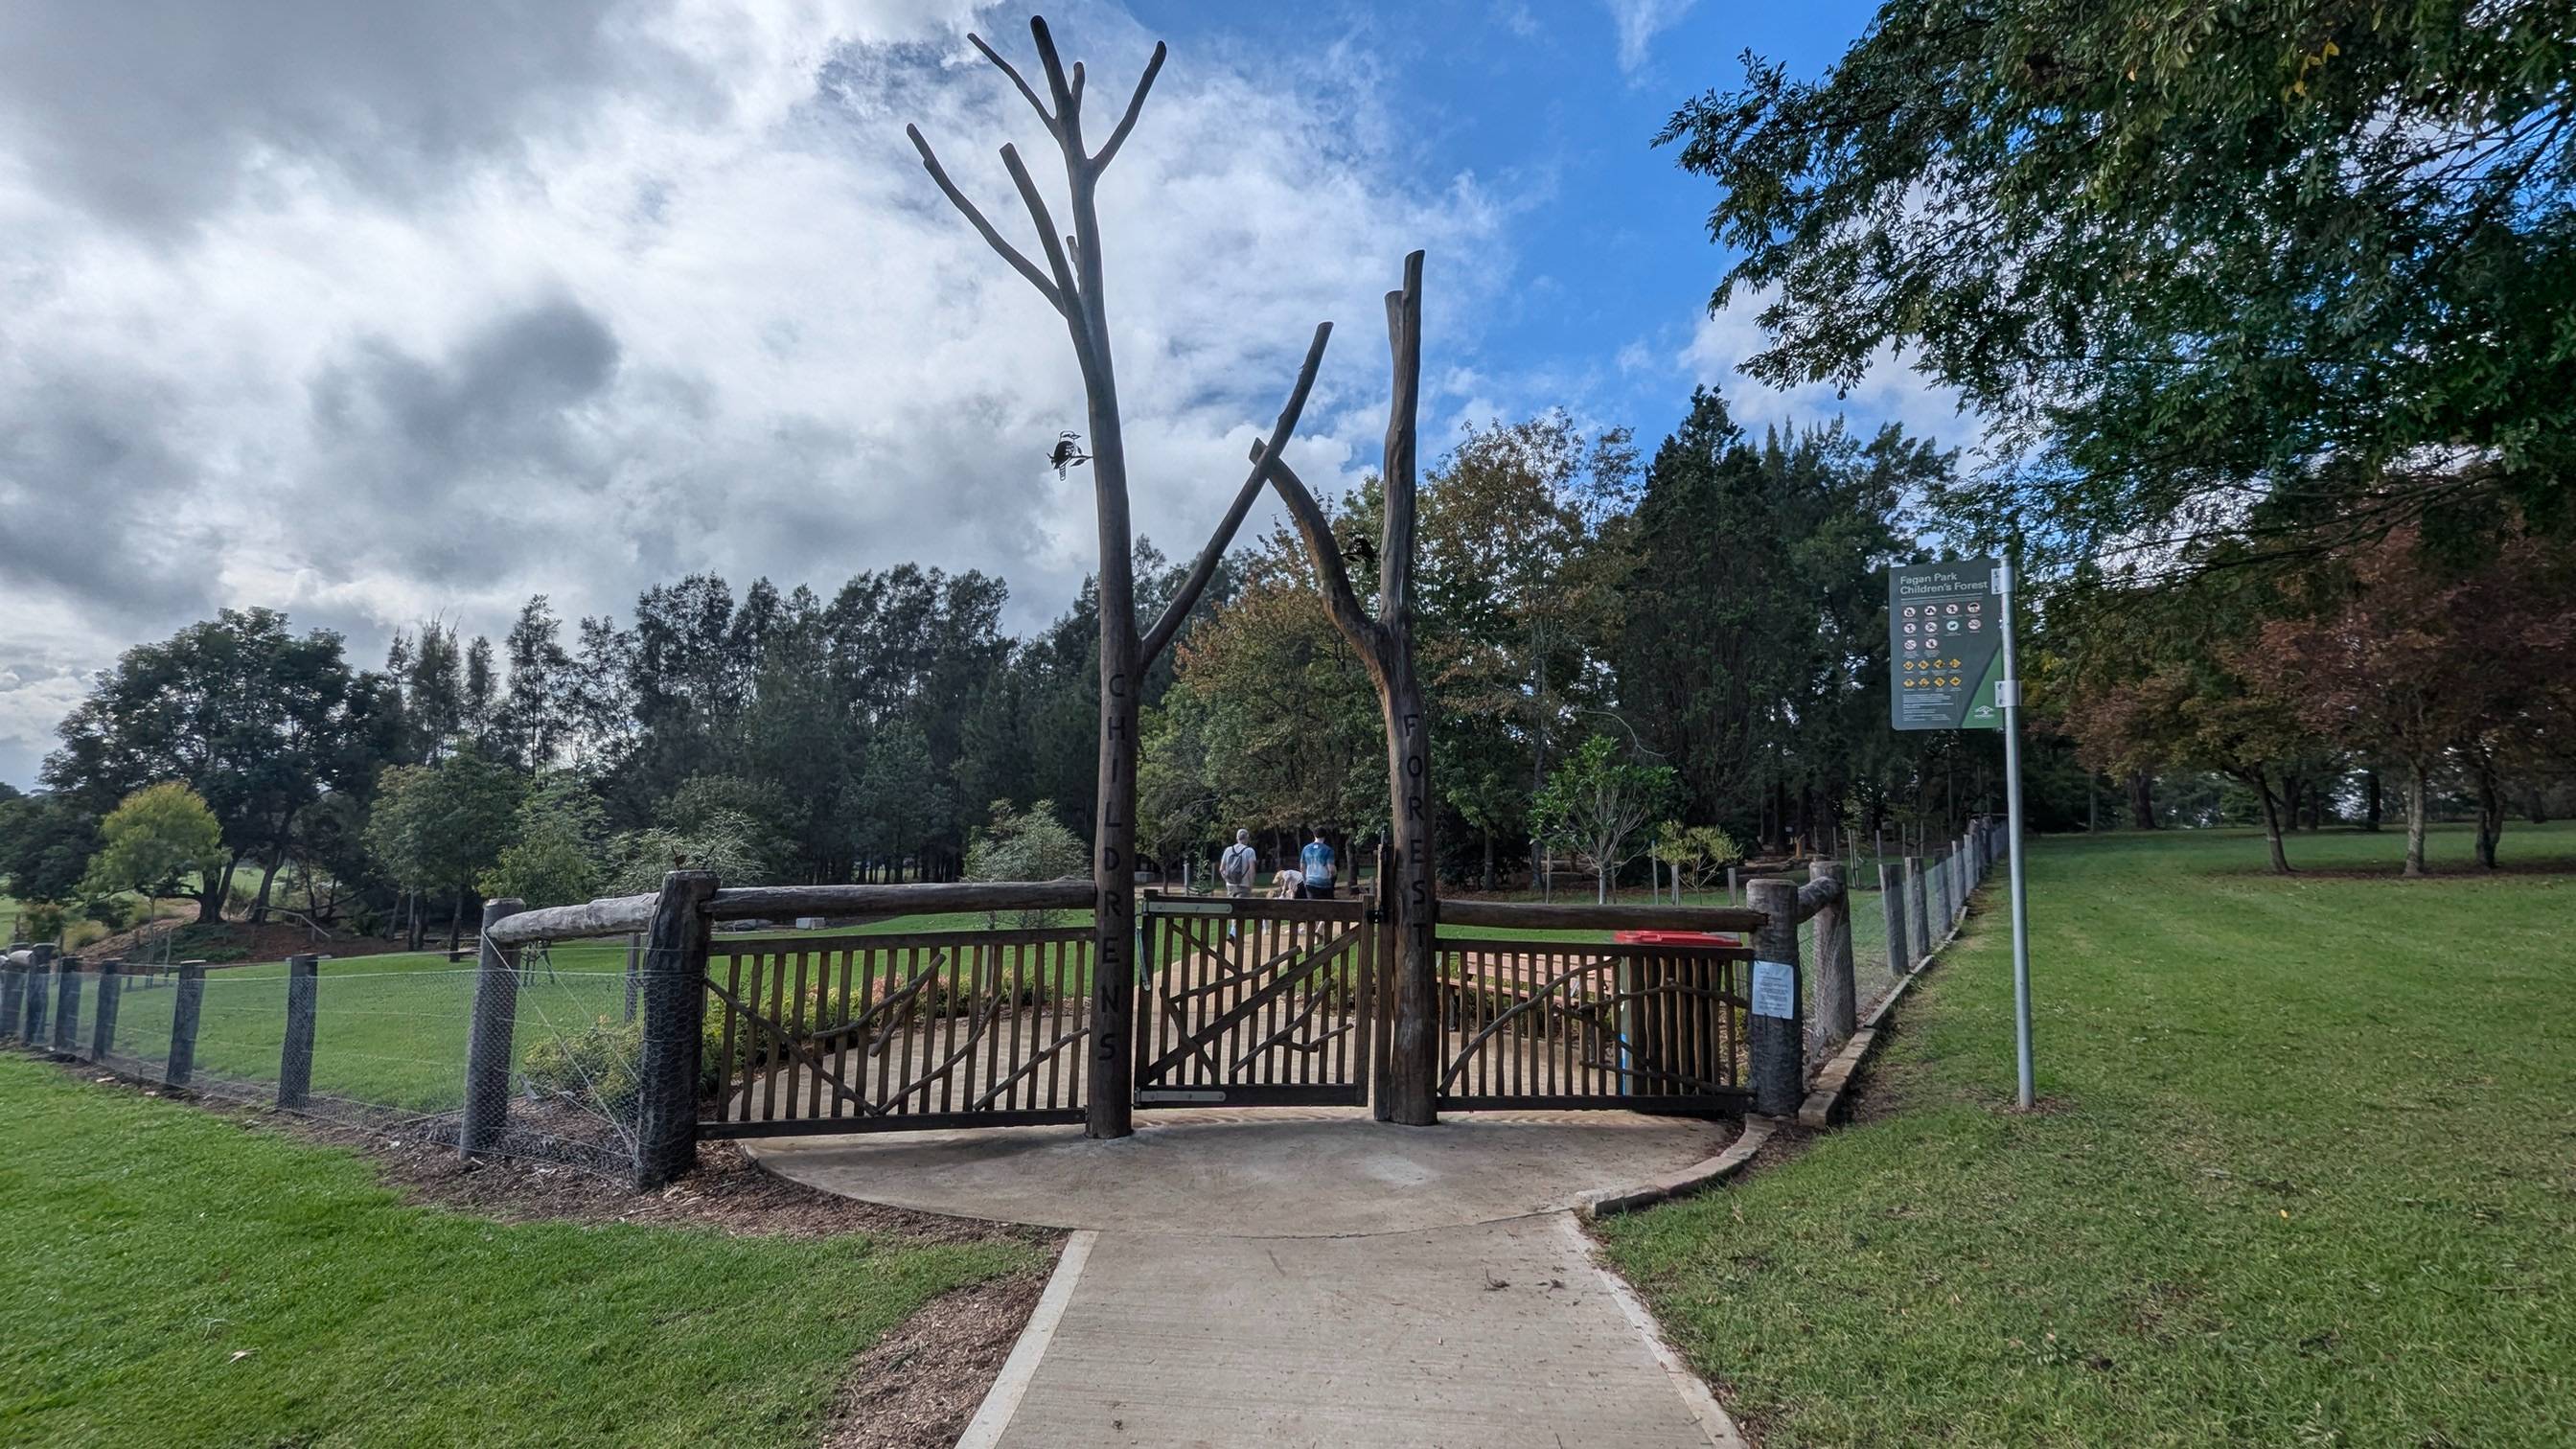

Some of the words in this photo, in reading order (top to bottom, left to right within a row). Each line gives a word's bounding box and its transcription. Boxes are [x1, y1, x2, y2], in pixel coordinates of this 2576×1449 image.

[1899, 575, 1931, 586] Fagan
[1934, 572, 1958, 582] Park
[1899, 583, 1952, 595] Children's
[1954, 581, 1989, 590] Forest
[1099, 674, 1126, 1061] CHILDRENS
[1403, 713, 1428, 948] FOREST
